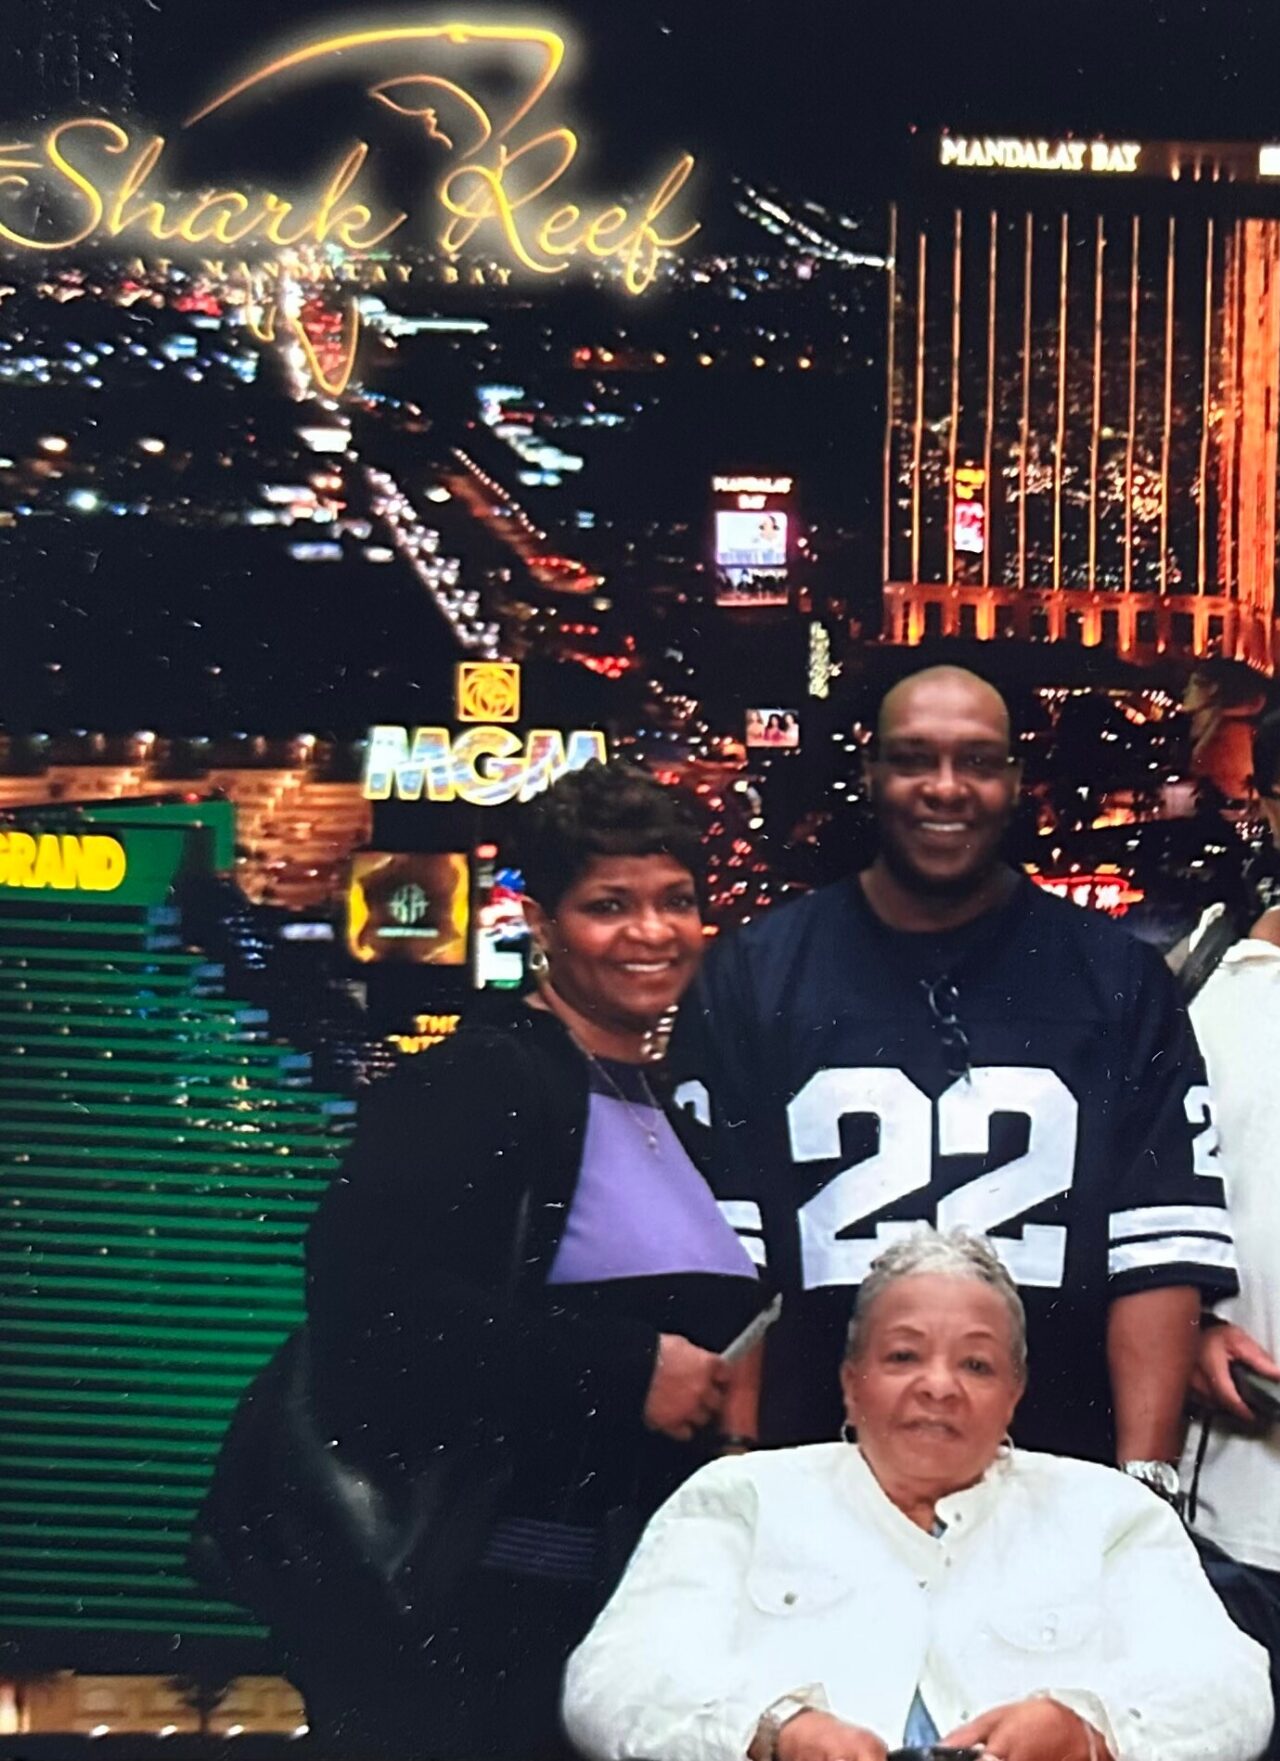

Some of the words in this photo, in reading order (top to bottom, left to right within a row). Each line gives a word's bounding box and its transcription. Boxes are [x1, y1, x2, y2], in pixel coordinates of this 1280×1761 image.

[941, 138, 1087, 170] MANDALAY
[1091, 142, 1141, 171] BAY
[362, 726, 607, 806] MGM
[0, 831, 126, 891] RAND
[787, 1066, 1079, 1290] 22
